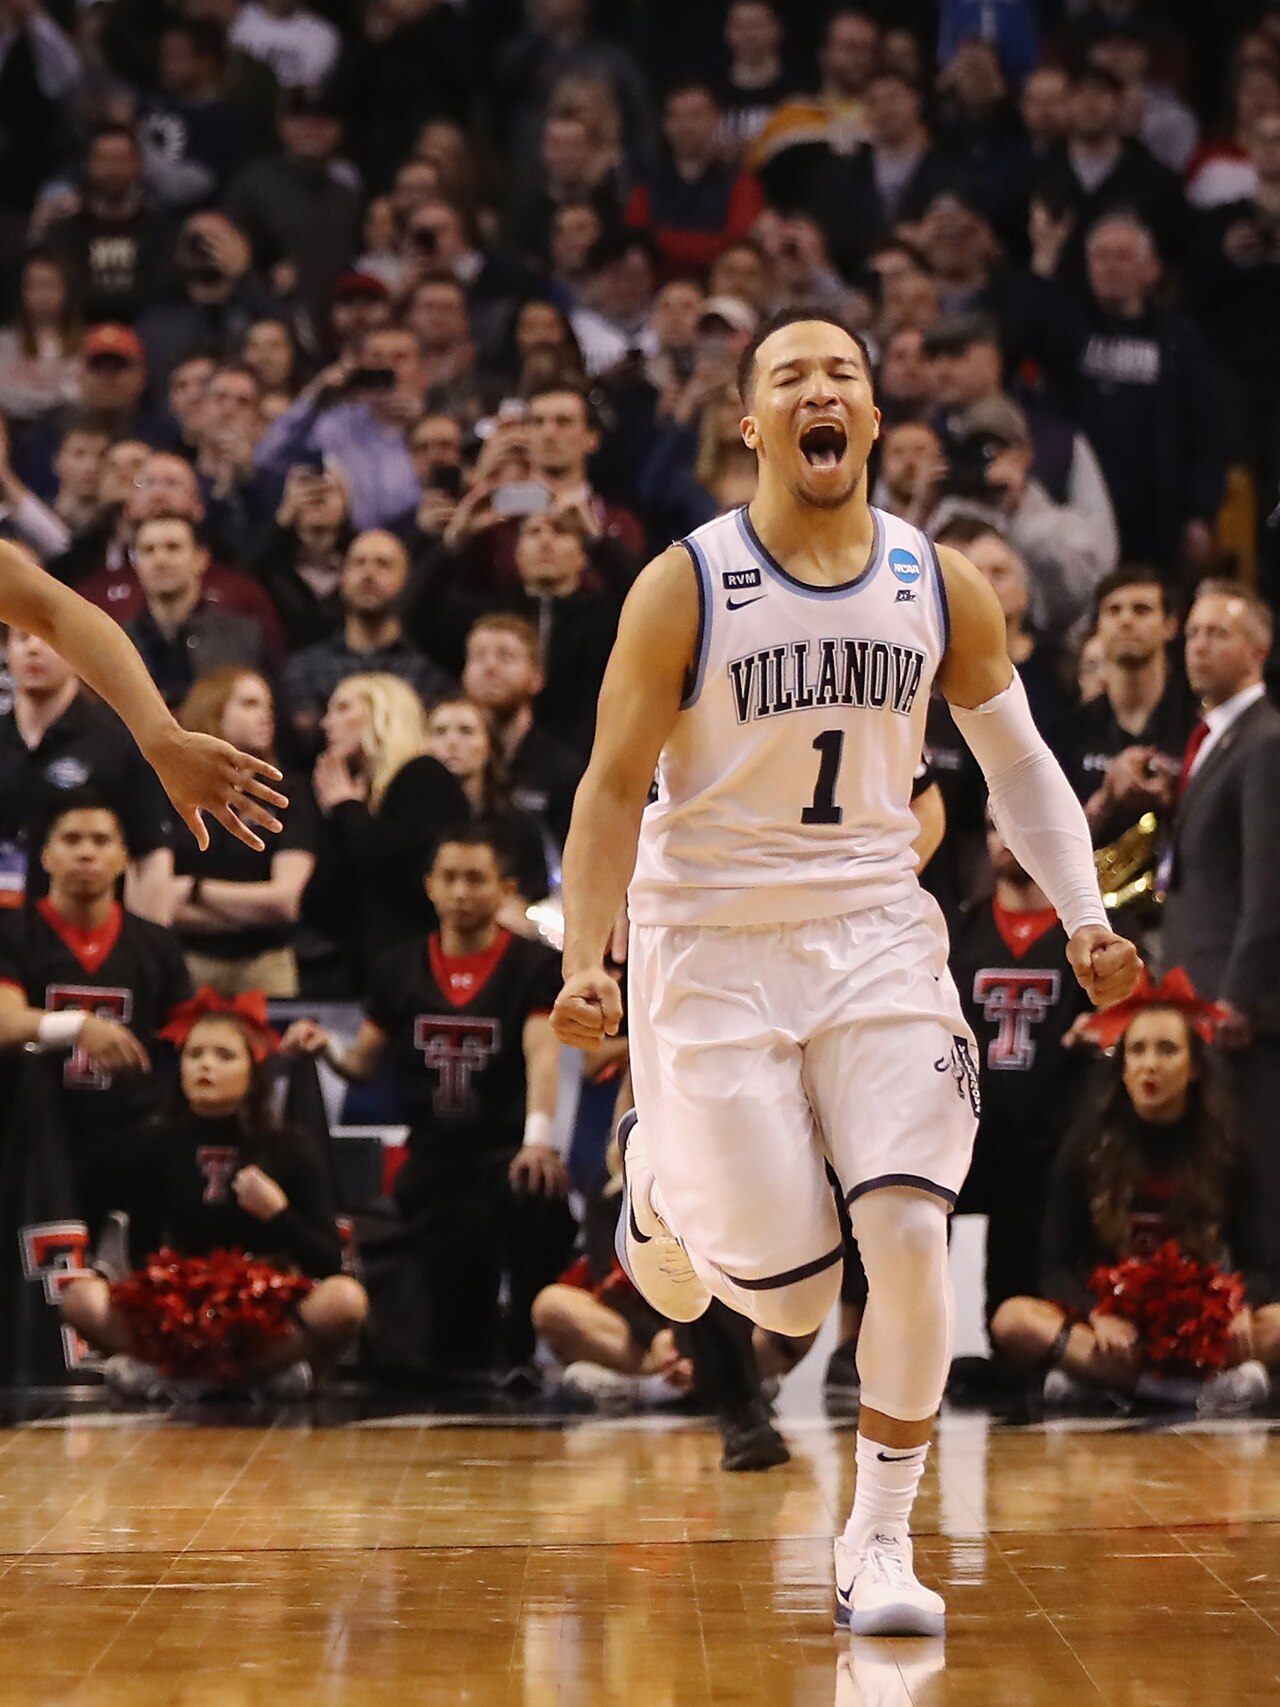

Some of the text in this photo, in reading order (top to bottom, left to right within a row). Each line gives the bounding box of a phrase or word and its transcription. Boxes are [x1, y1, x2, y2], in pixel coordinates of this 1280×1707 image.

[728, 572, 757, 586] RVM
[894, 563, 920, 575] NCAA
[728, 638, 927, 725] VILLANOVA
[800, 730, 845, 825] 1
